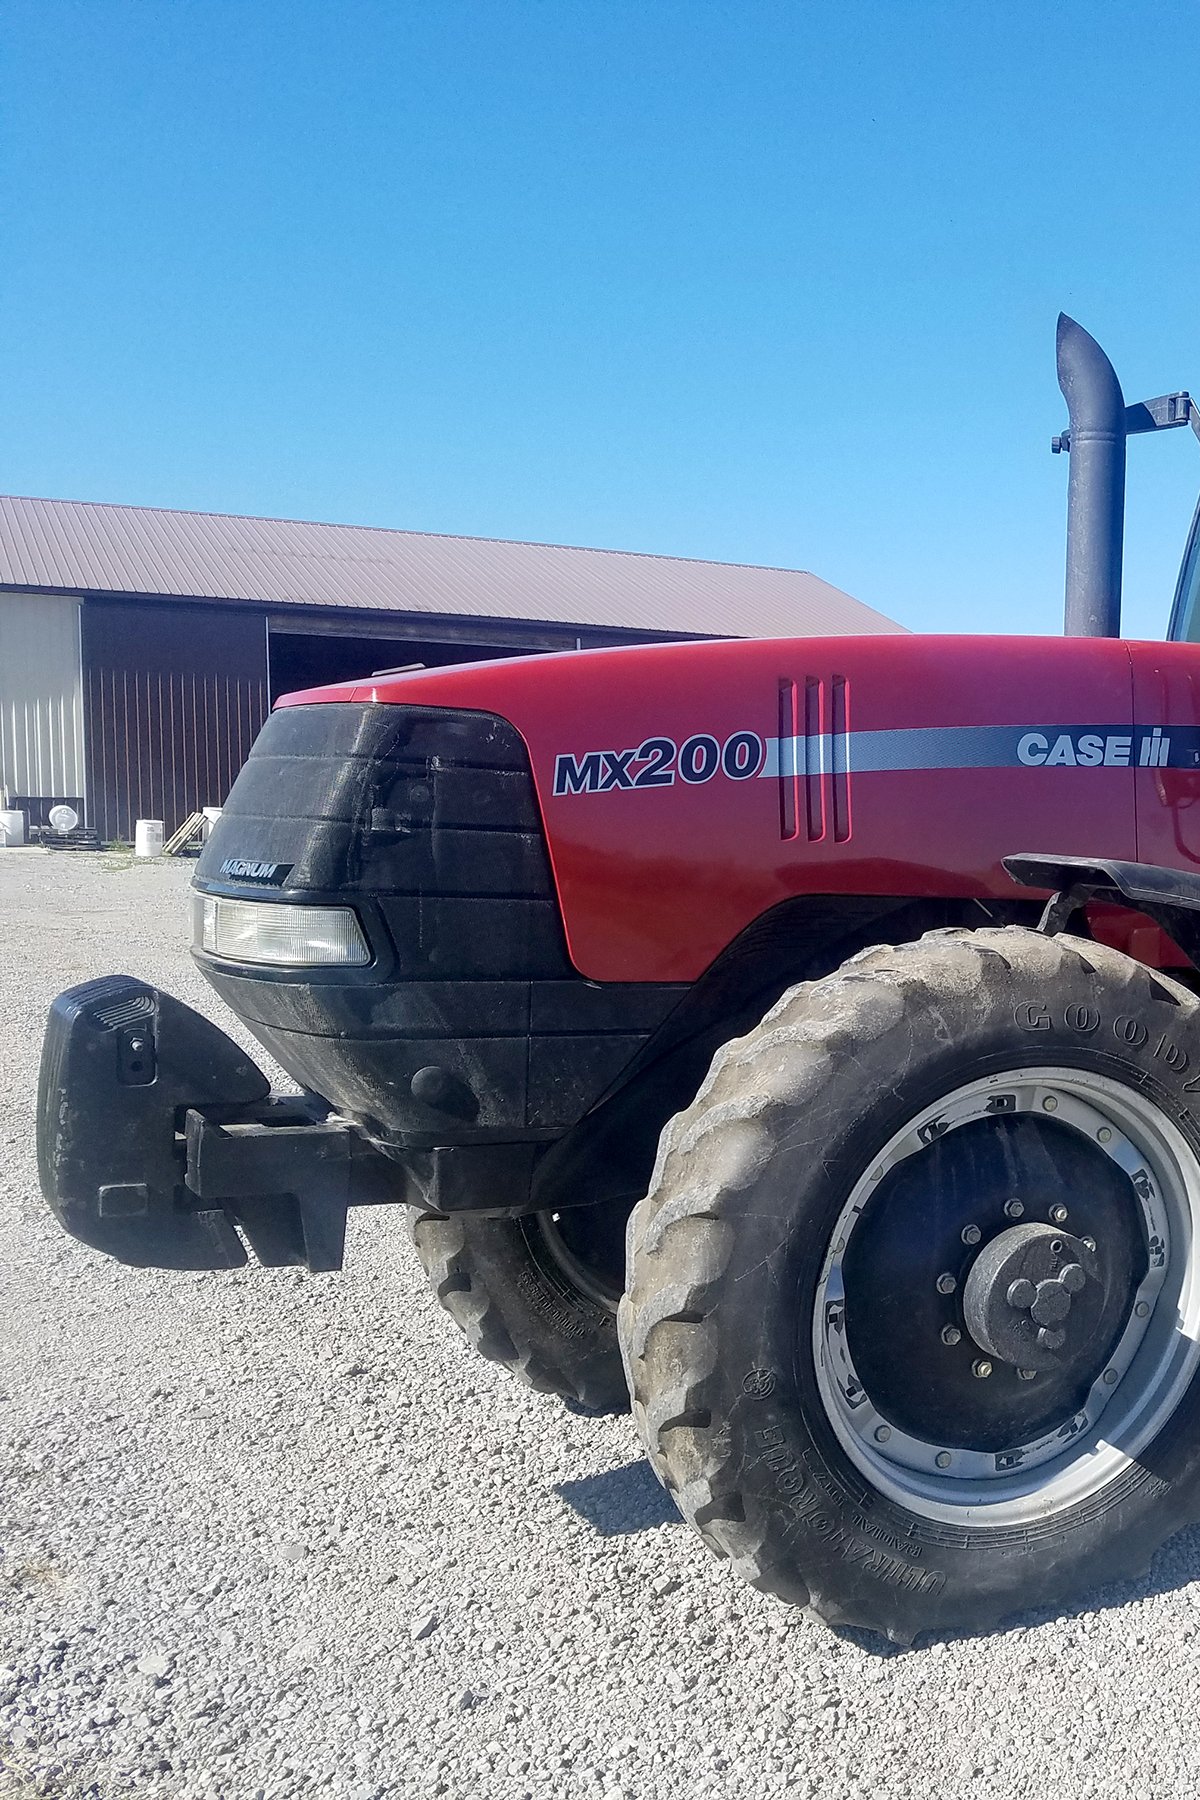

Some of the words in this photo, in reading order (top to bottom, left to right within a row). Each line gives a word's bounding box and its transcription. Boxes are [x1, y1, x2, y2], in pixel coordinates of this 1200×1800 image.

[552, 730, 762, 796] MX200
[1017, 732, 1132, 767] CASE
[220, 859, 278, 878] MAGNUM
